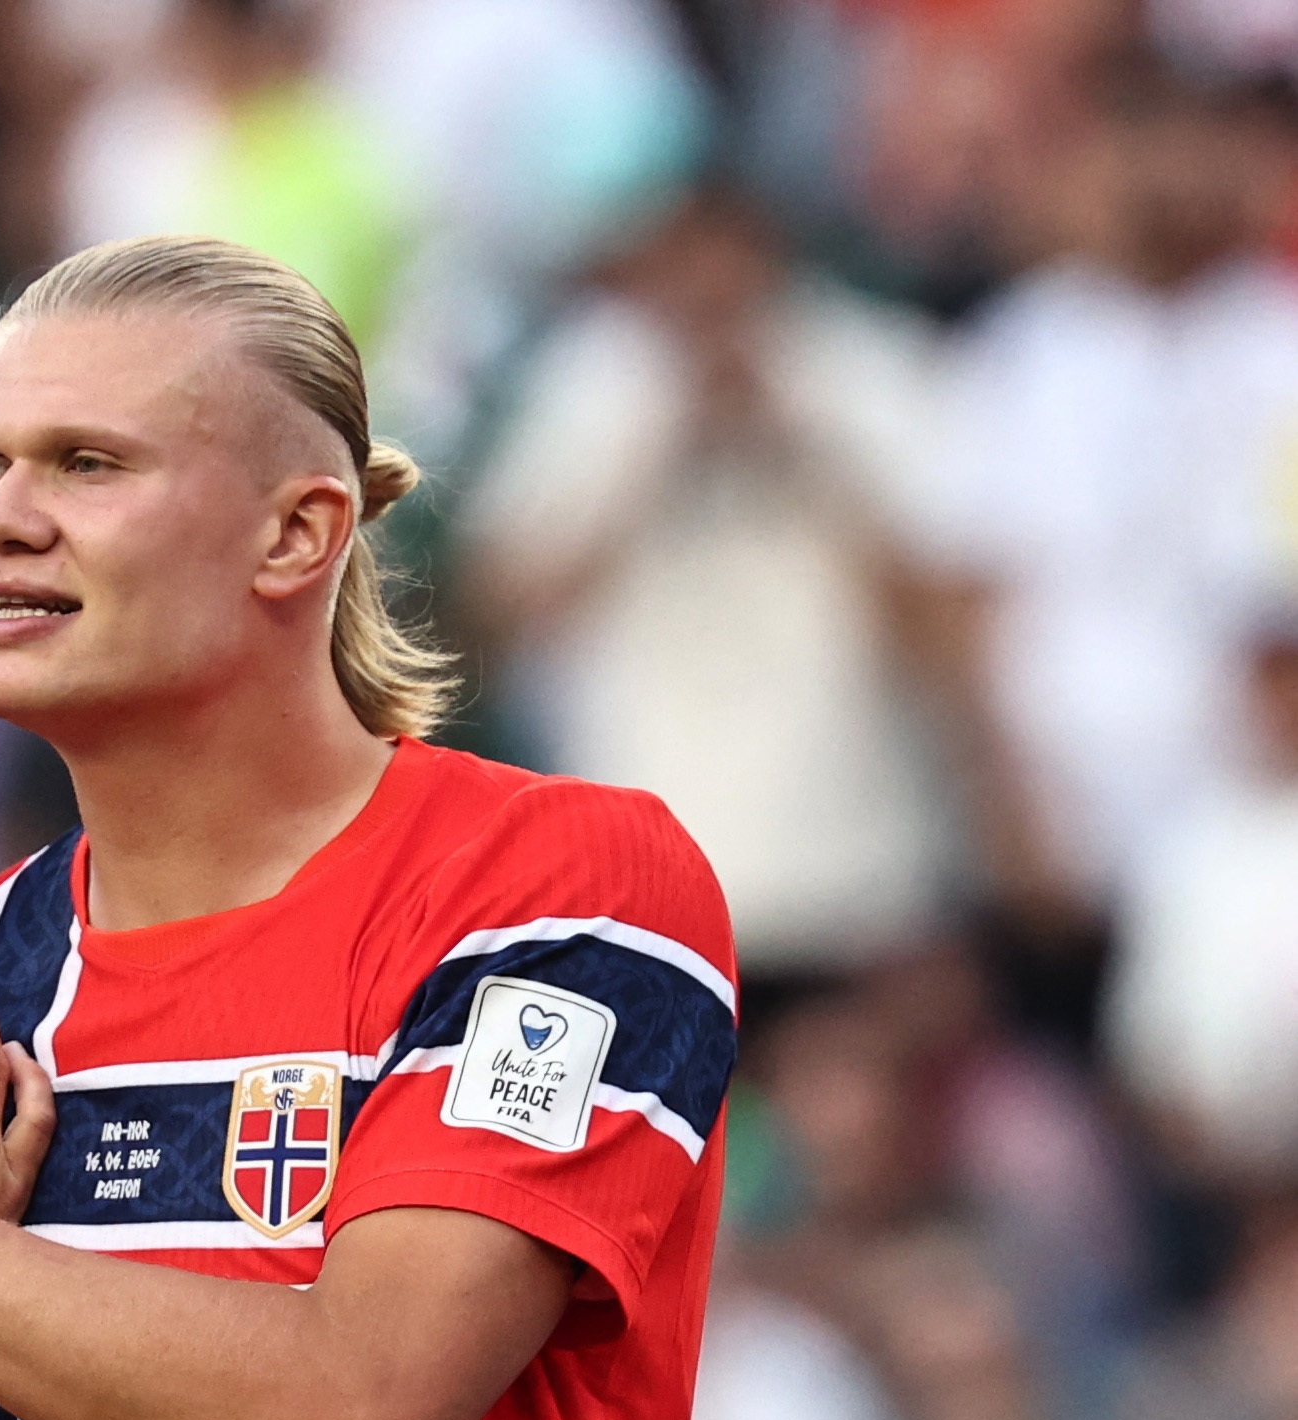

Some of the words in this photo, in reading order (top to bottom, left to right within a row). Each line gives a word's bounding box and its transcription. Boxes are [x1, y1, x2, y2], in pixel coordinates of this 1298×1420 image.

[272, 1068, 305, 1084] NORGE
[491, 1048, 539, 1079] Unite
[541, 1060, 568, 1083] For
[489, 1078, 558, 1113] PEACE
[497, 1106, 532, 1124] FIFA
[94, 1177, 142, 1199] BOSTON
